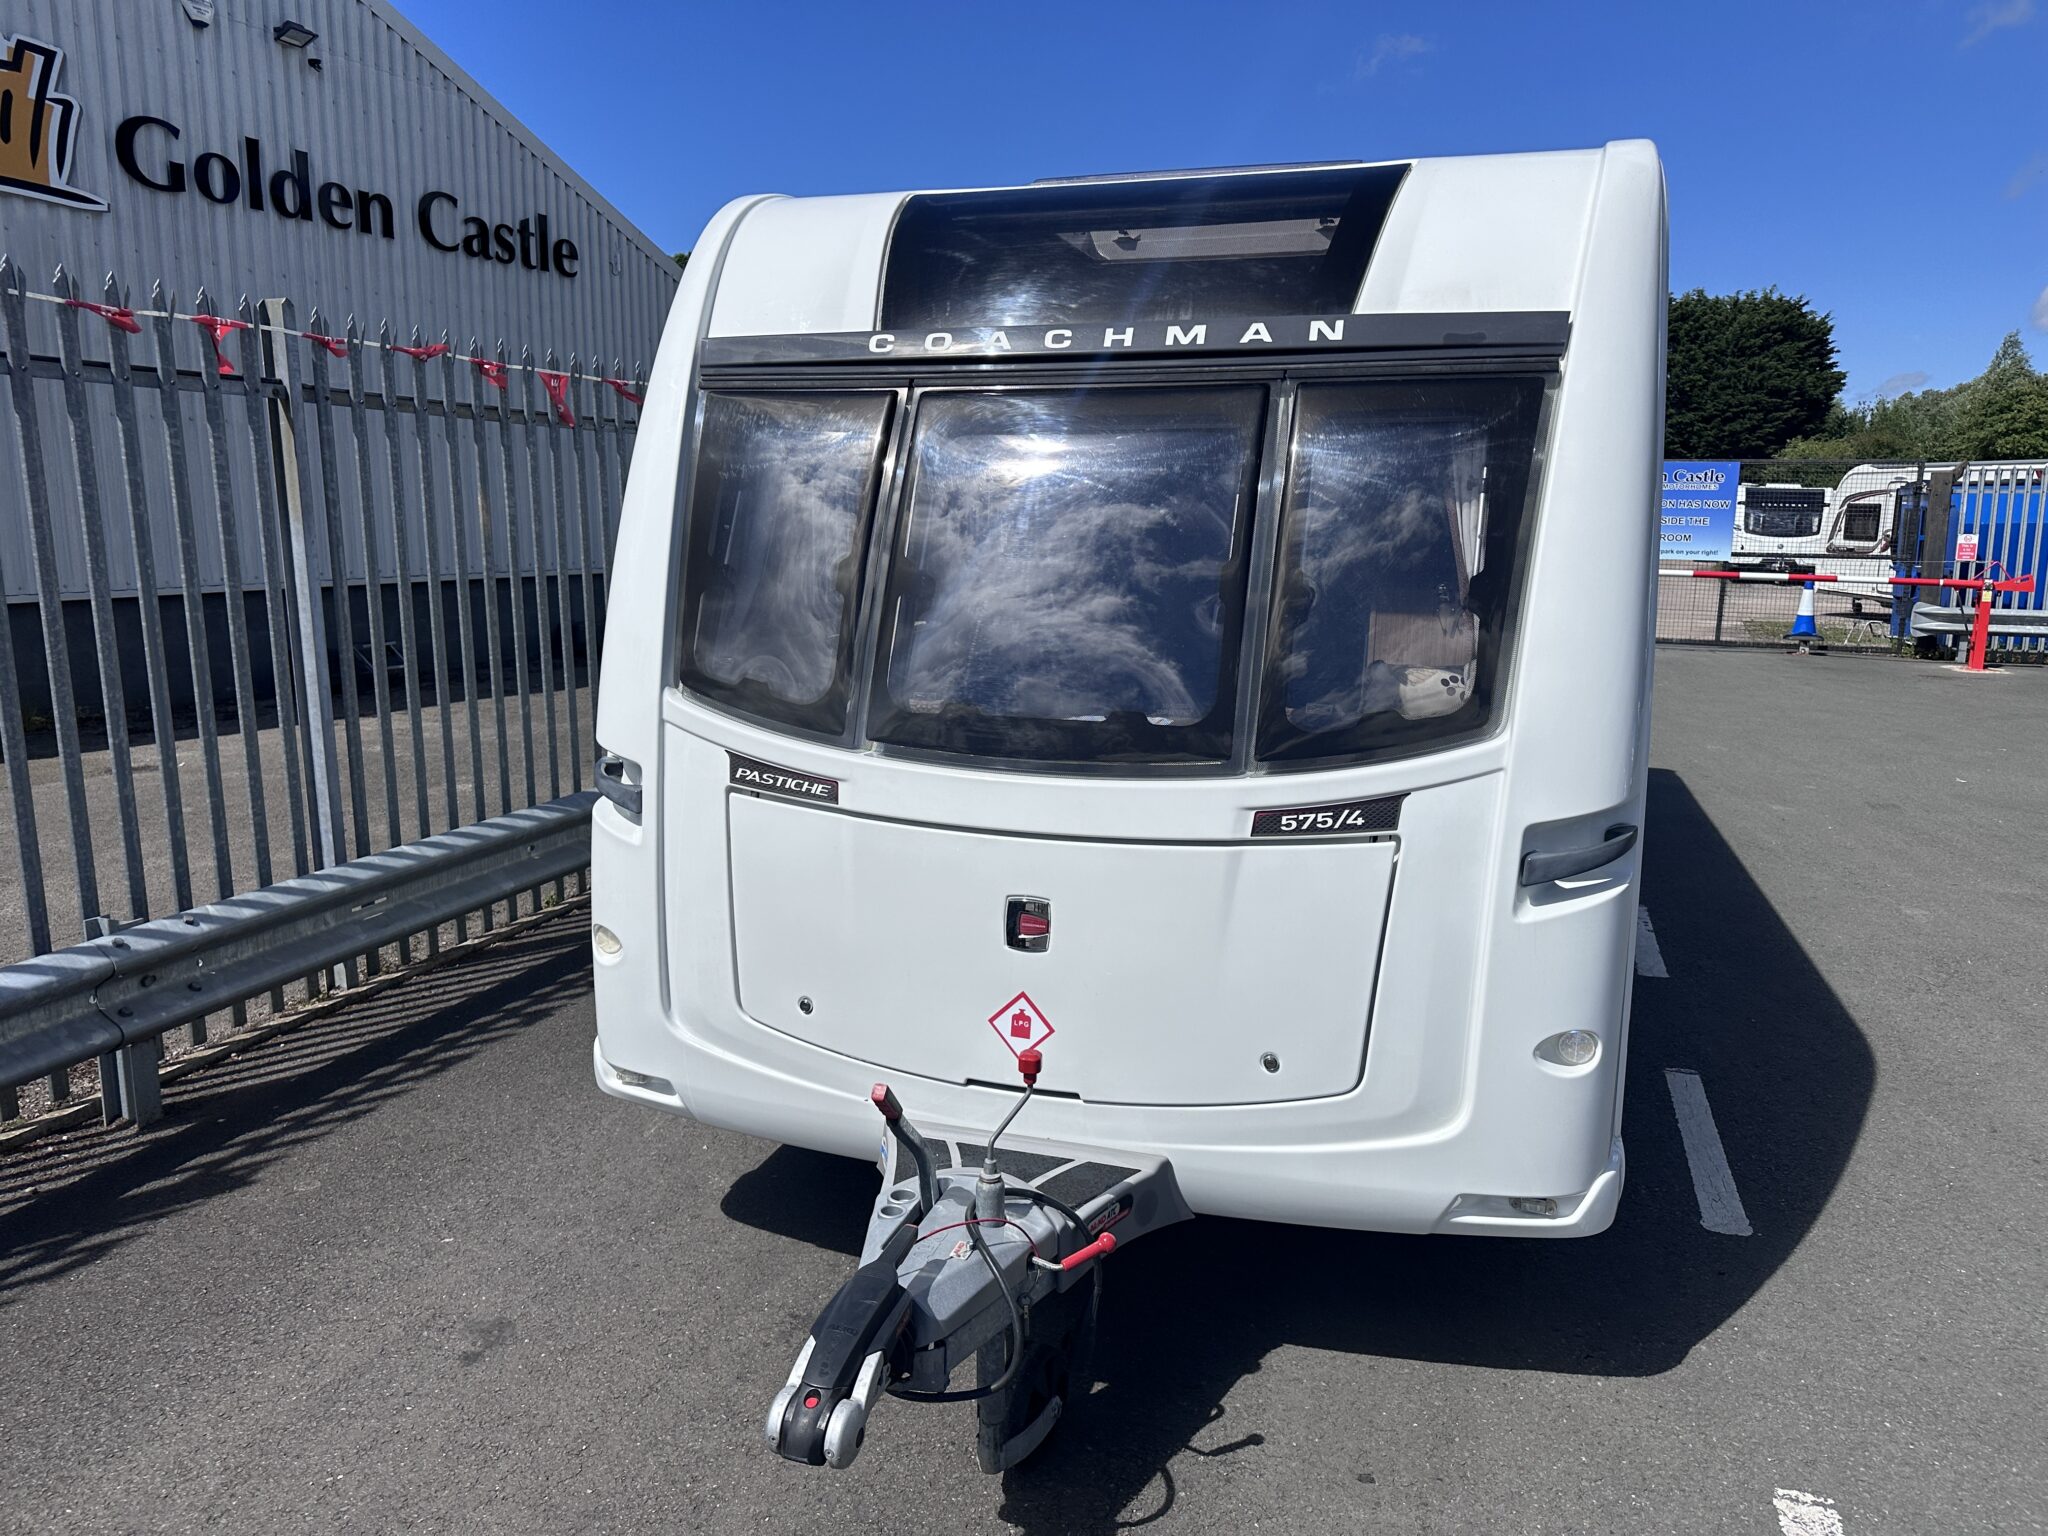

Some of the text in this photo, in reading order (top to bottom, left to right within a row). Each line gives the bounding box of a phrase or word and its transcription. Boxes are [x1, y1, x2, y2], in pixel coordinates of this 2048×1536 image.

[115, 115, 579, 278] Golden Castle
[868, 319, 1345, 354] COACHMAN
[1673, 468, 1725, 483] Castle
[1678, 500, 1701, 509] HAS
[1703, 500, 1731, 509] NOW
[1688, 517, 1710, 526] THE
[735, 767, 832, 797] PASTICHE
[1280, 809, 1365, 831] 575/4
[1013, 1020, 1029, 1028] LPG
